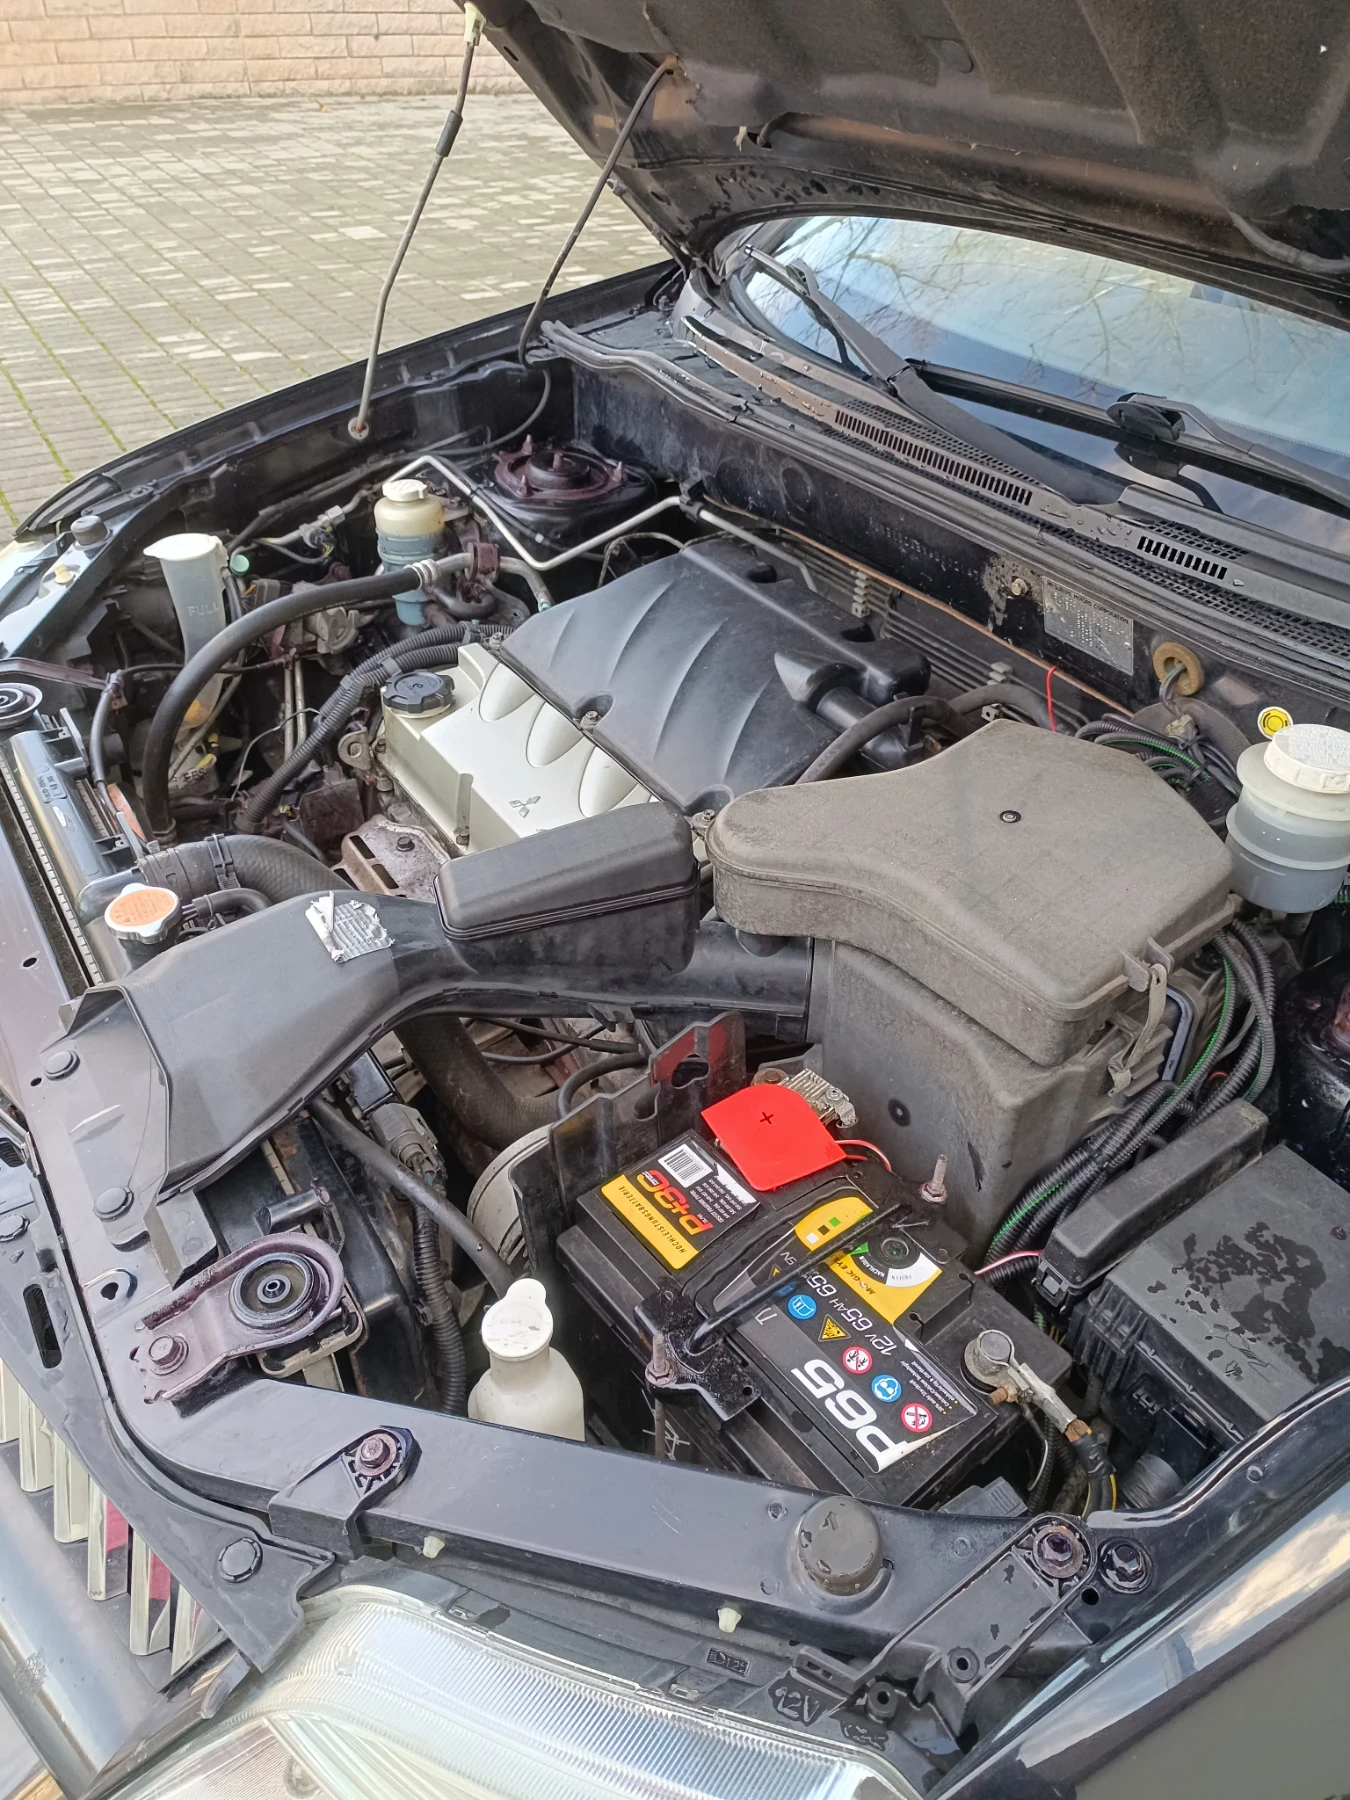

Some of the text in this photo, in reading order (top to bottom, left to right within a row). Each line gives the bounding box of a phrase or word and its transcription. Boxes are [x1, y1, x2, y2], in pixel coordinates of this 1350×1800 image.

[187, 602, 220, 617] FULL
[618, 1185, 687, 1254] HOCHLEISTUNGSBATTERIE
[858, 1254, 886, 1278] NACHLADEN
[864, 1333, 898, 1356] 12V
[790, 1358, 909, 1464] P65
